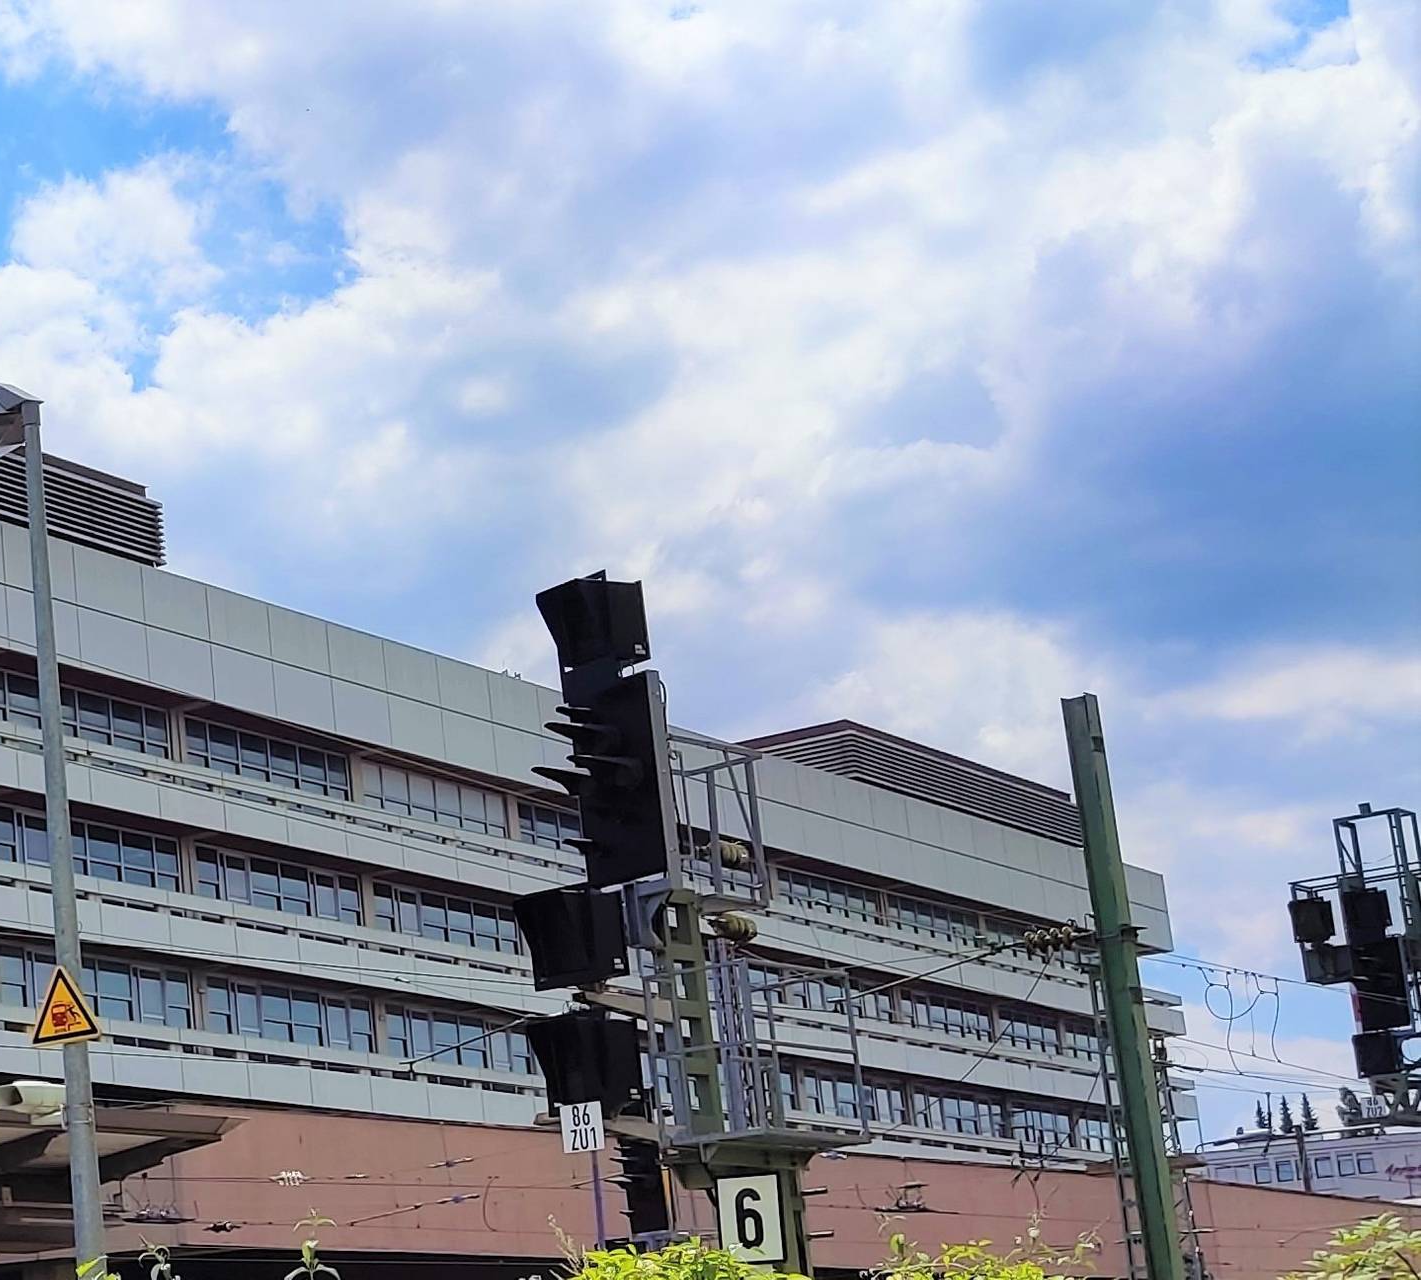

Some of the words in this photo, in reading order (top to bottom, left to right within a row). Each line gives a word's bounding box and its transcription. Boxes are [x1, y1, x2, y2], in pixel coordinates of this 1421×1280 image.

[572, 1104, 590, 1127] 86
[570, 1126, 597, 1151] ZU1
[735, 1188, 764, 1249] 6
